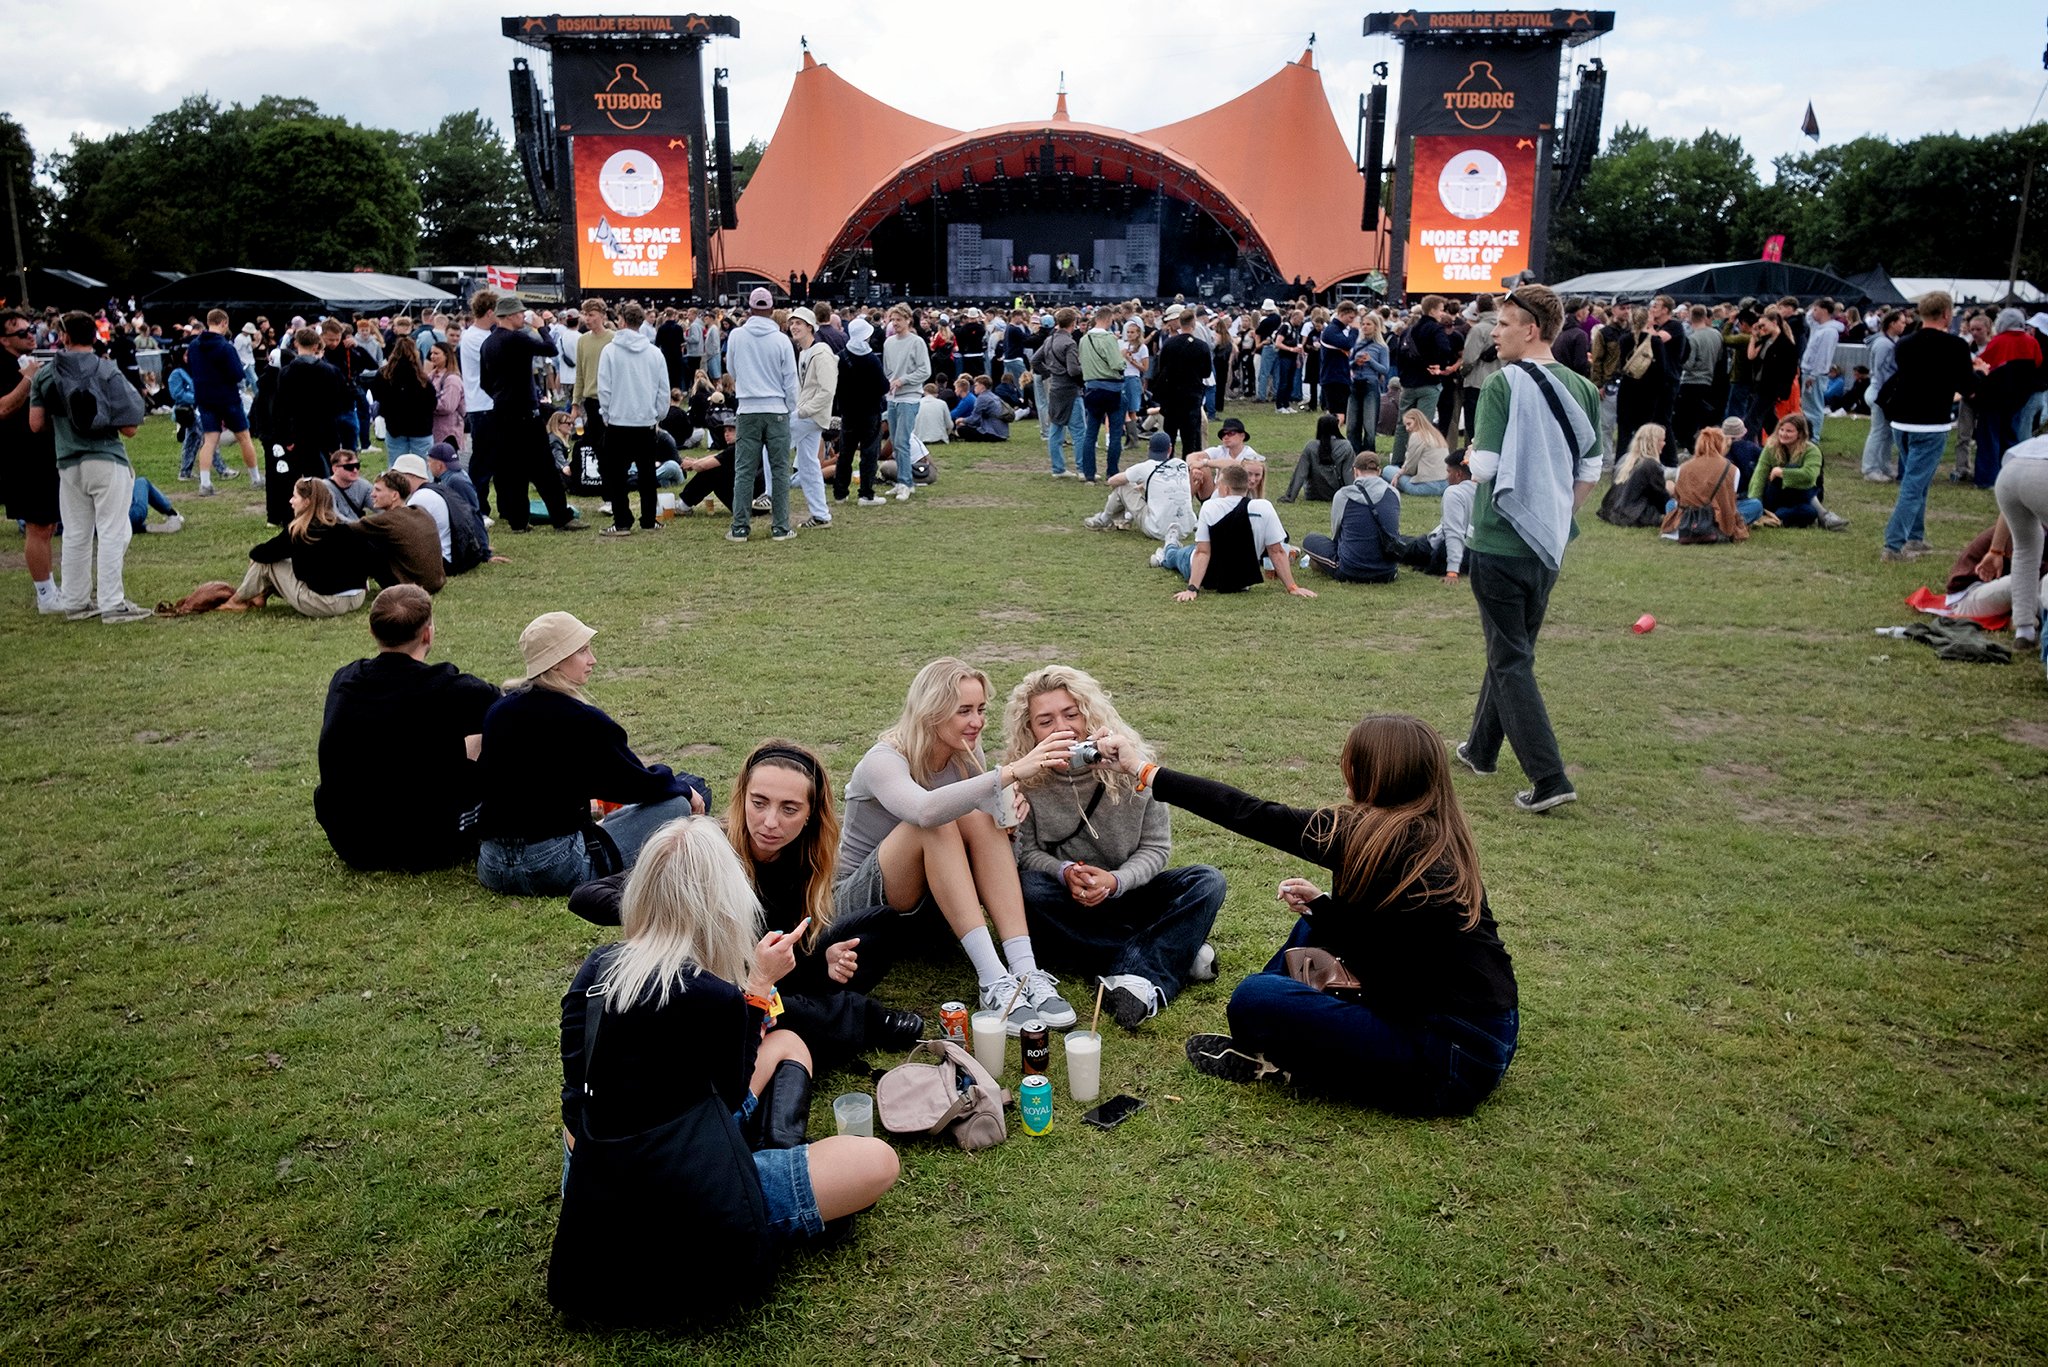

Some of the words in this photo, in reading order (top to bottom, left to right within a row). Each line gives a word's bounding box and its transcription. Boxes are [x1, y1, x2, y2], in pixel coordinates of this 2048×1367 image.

[557, 17, 616, 32] ROSKILDE
[617, 17, 674, 31] FESTIVAL
[1429, 13, 1492, 28] ROSKILDE
[1494, 13, 1554, 27] FESTIVAL
[594, 93, 662, 110] TUBORG
[1443, 92, 1514, 109] TUBORG
[588, 227, 631, 243] MRE
[633, 227, 681, 243] SPACE
[1420, 230, 1467, 246] MORE
[1469, 230, 1520, 246] SPACE
[647, 244, 668, 260] OF
[1434, 248, 1480, 263] WEST
[1482, 247, 1504, 263] OF
[613, 261, 659, 276] STAGE
[1443, 265, 1492, 280] STAGE
[1023, 1105, 1050, 1115] ROYAL
